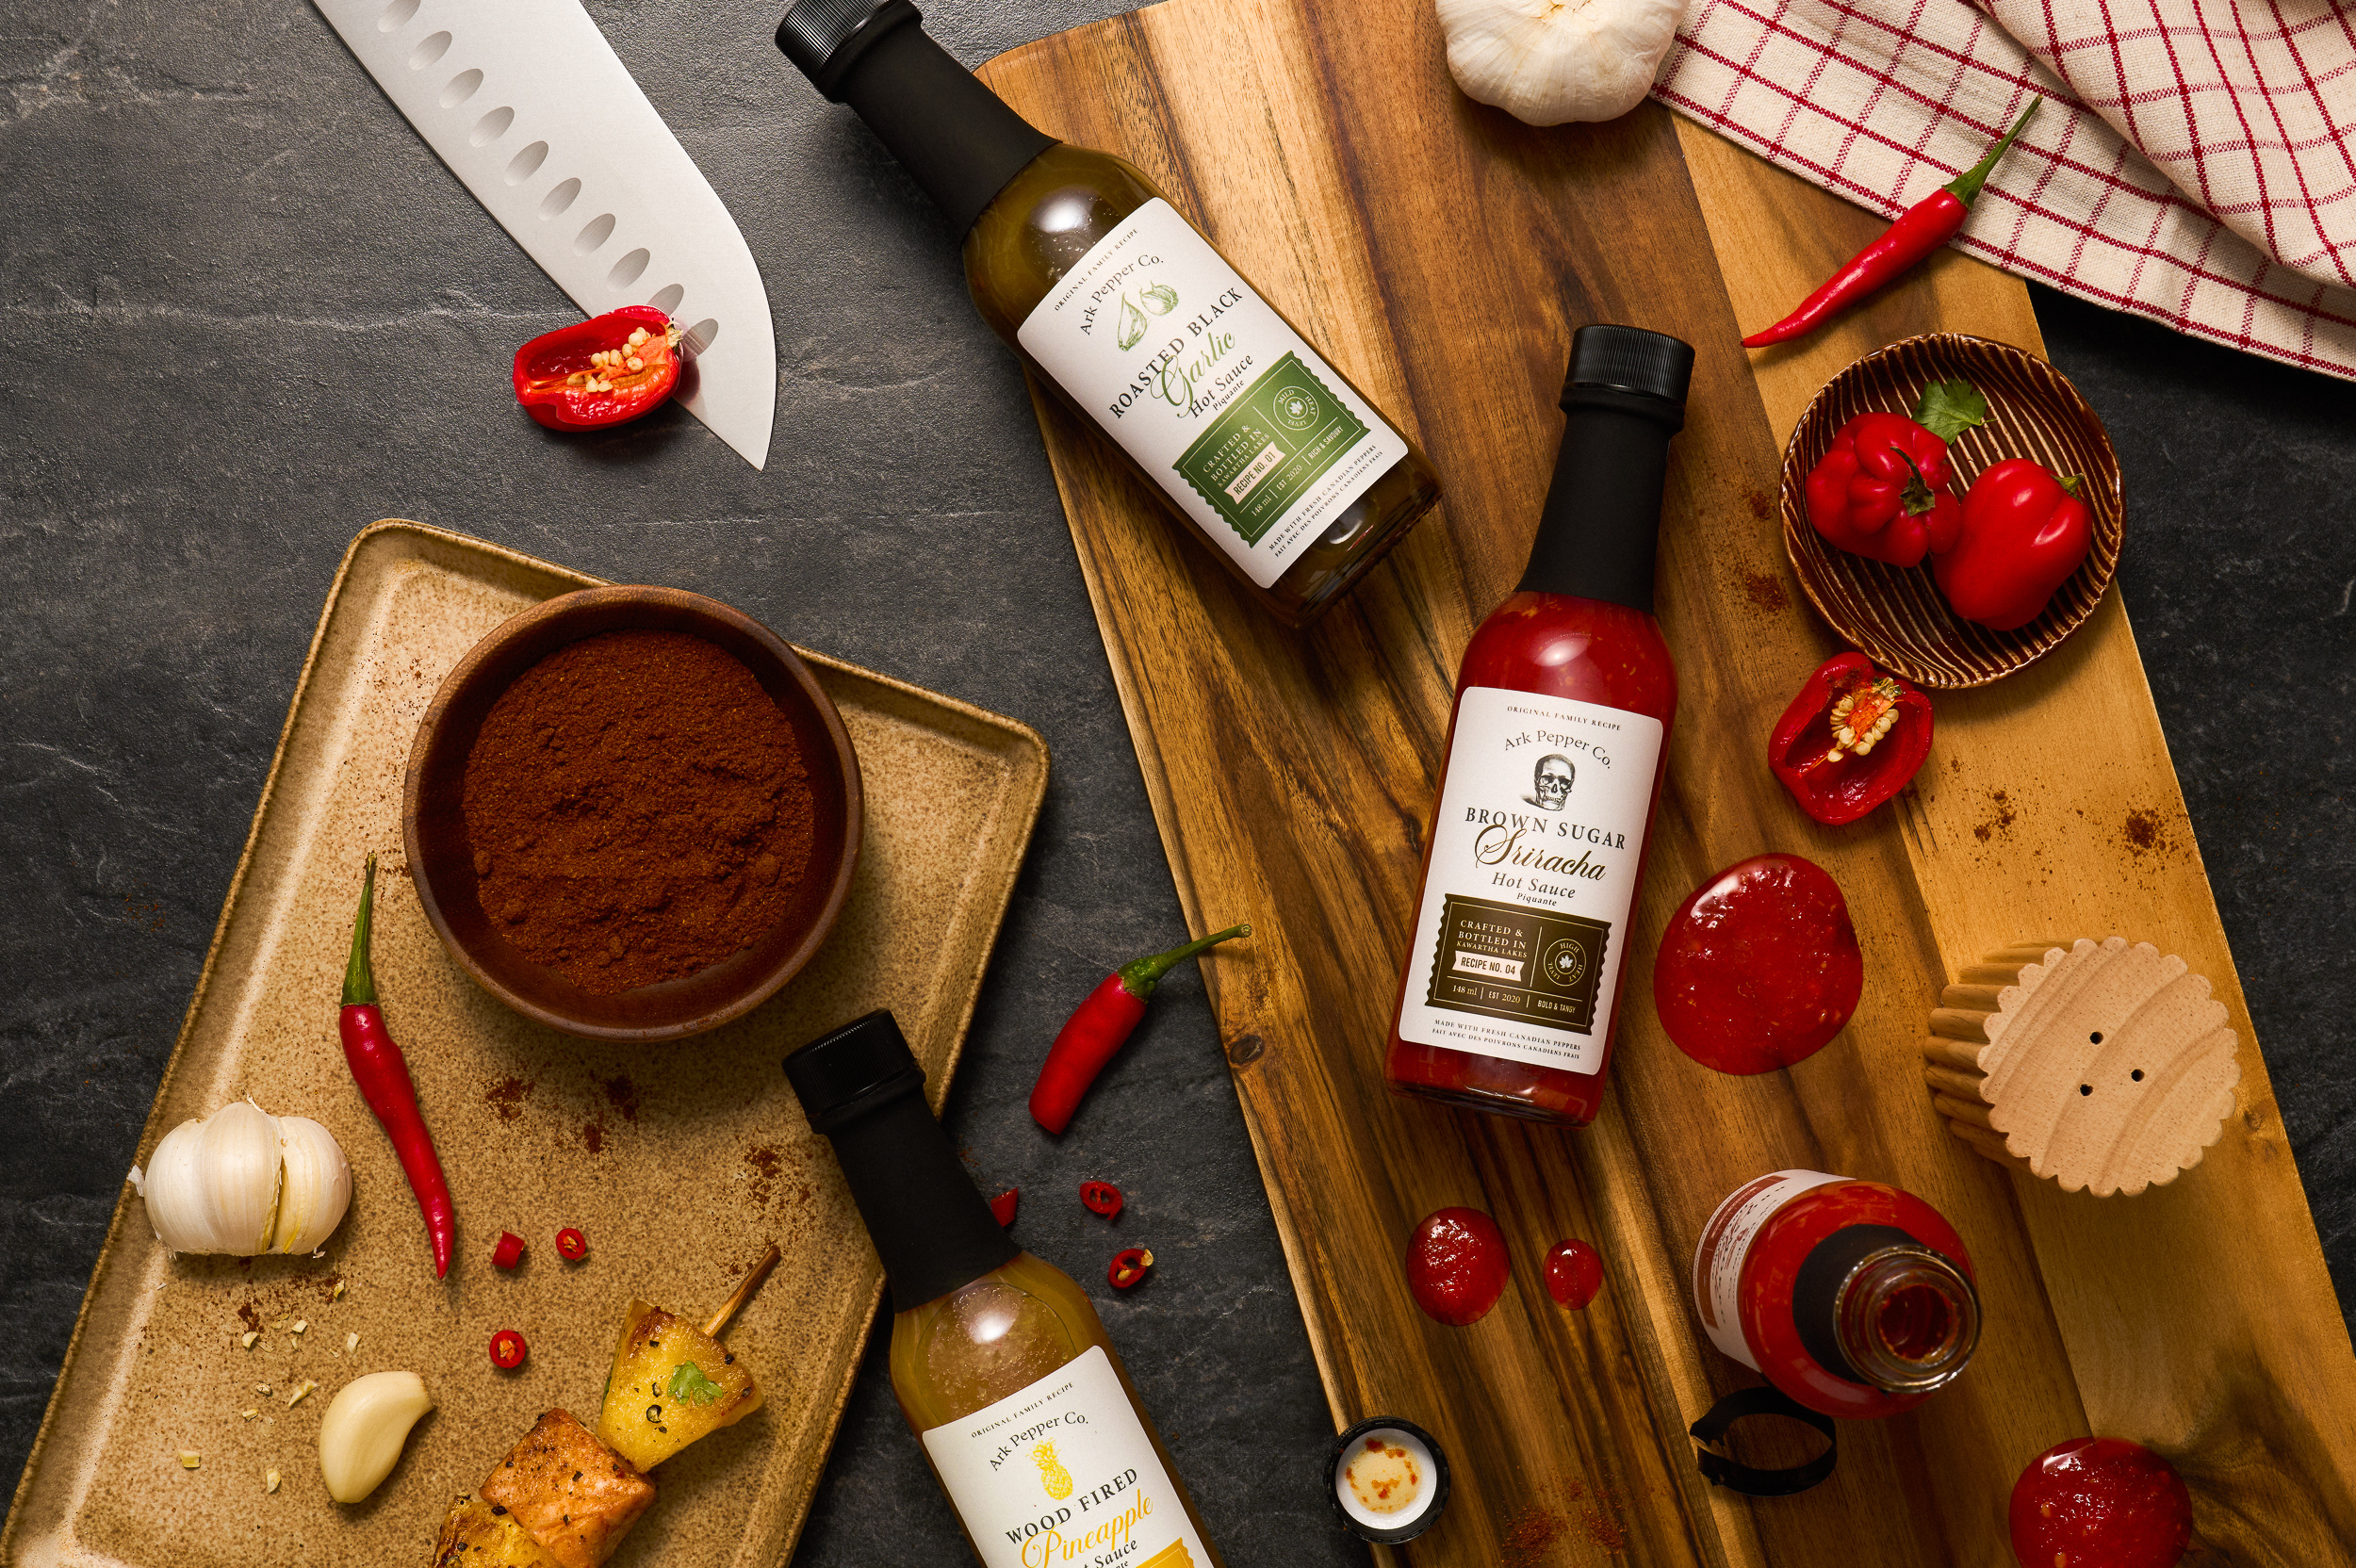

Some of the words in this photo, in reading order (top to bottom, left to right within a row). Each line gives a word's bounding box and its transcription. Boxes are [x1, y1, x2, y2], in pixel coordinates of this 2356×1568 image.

[1055, 277, 1088, 311] ORIGINAL
[1088, 251, 1113, 275] FAMILY
[1114, 228, 1137, 250] RECIPE
[1080, 305, 1097, 335] Ark
[1091, 263, 1135, 303] Pepper
[1137, 254, 1164, 267] Co.
[1109, 337, 1185, 419] ROASTED
[1186, 287, 1242, 337] BLACK
[1151, 333, 1235, 418] Garlic
[1188, 389, 1216, 418] Hot
[1215, 355, 1253, 391] Sauce
[1213, 380, 1244, 411] Piquante
[1277, 389, 1295, 404] MILD
[1304, 396, 1316, 416] HEAT
[1203, 433, 1241, 473] CRAFTED
[1210, 441, 1249, 482] BOTTLED
[1250, 428, 1262, 441] IN
[1307, 446, 1322, 460] RICH
[1323, 425, 1344, 445] SAVOURY
[1218, 455, 1250, 487] KAWARTHA
[1250, 433, 1269, 454] LAKES
[1234, 469, 1257, 495] RECIPE
[1254, 462, 1268, 476] NO.
[1264, 451, 1276, 463] 01
[1276, 480, 1287, 491] EST
[1285, 464, 1302, 482] 2020
[1251, 503, 1264, 516] 148
[1262, 495, 1272, 507] ml
[1268, 532, 1285, 550] MADE
[1284, 516, 1302, 533] WITH
[1301, 496, 1322, 516] FRESH
[1322, 466, 1353, 496] CANADIAN
[1353, 445, 1376, 466] PEPPERS
[1274, 545, 1286, 558] FAIT
[1286, 531, 1301, 545] AVEC
[1301, 519, 1312, 531] DES
[1312, 491, 1340, 520] POIVRONS
[1340, 463, 1369, 492] CANADIENS
[1369, 450, 1383, 465] FRAIS
[1507, 706, 1550, 717] ORIGINAL
[1555, 713, 1588, 725] FAMILY
[1591, 720, 1621, 731] RECIPE
[1505, 732, 1531, 751] Ark
[1537, 729, 1590, 750] Pepper
[1593, 746, 1611, 769] Co.
[1465, 808, 1548, 833] BROWN
[1557, 822, 1626, 849] SUGAR
[1475, 824, 1606, 881] Sriracha
[1492, 872, 1523, 889] Hot
[1529, 878, 1576, 898] Sauce
[1516, 892, 1557, 906] Piquante
[1458, 931, 1509, 946] BOTTLED
[1513, 939, 1527, 949] IN
[1460, 920, 1511, 935] CRAFTED
[1514, 928, 1523, 937] &
[1456, 940, 1498, 953] KAWARTHA
[1502, 948, 1528, 958] LAKES
[1560, 942, 1579, 954] HIGH
[1461, 956, 1487, 970] RECIPE
[1489, 961, 1502, 972] NO.
[1505, 964, 1515, 974] 04
[1547, 961, 1561, 980] LEVEL
[1568, 964, 1583, 983] HEAT
[1452, 985, 1466, 994] 148
[1466, 987, 1477, 995] ml
[1488, 990, 1499, 1000] EST
[1502, 993, 1520, 1003] 2020
[1537, 999, 1552, 1009] BOLD
[1560, 1004, 1576, 1014] TANGY
[1434, 1019, 1455, 1028] MADE
[1458, 1023, 1479, 1032] WITH
[1481, 1027, 1507, 1037] FRESH
[1509, 1032, 1551, 1045] CANADIAN
[1553, 1040, 1581, 1051] PEPPERS
[1448, 1031, 1466, 1039] AVEC
[1483, 1037, 1521, 1049] POIVRONS
[1523, 1044, 1562, 1056] CANADIENS
[1563, 1051, 1579, 1059] FRAIS
[971, 1416, 1012, 1438] ORIGINAL
[1013, 1399, 1044, 1419] FAMILY
[1046, 1381, 1074, 1401] RECIPE
[990, 1446, 1012, 1471] Ark
[1009, 1417, 1060, 1447] Pepper
[1064, 1412, 1088, 1424] Co.
[1006, 1508, 1072, 1544] WOOD
[1078, 1468, 1137, 1511] FIRED
[1021, 1488, 1153, 1568] Pineapple
[1094, 1540, 1137, 1568] Sauce
